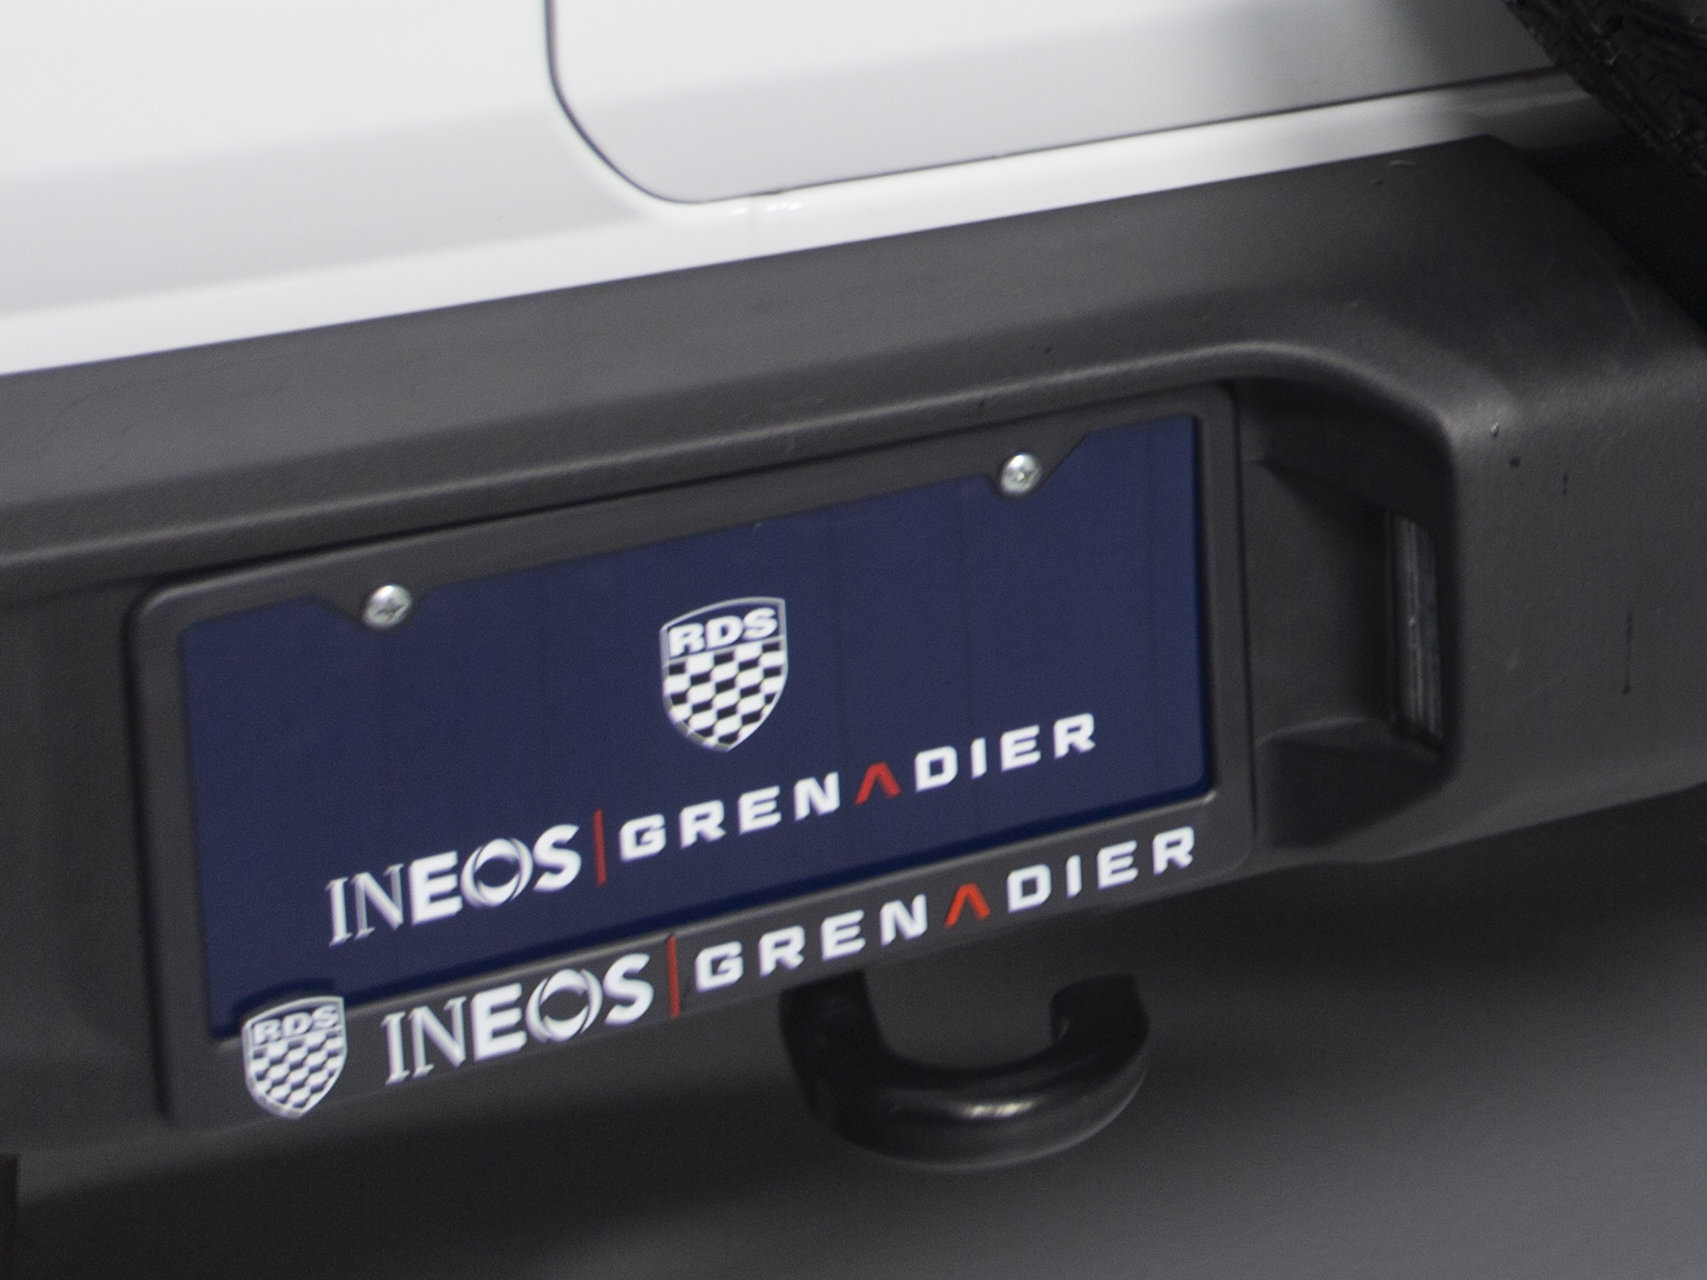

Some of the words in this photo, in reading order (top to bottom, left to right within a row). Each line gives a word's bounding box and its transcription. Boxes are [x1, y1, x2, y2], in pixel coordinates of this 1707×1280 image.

[668, 604, 778, 659] RDS
[324, 823, 582, 947] INEOS
[617, 712, 1096, 865] GRENADIER
[249, 1002, 337, 1049] RDS
[380, 951, 655, 1088] INEOS
[692, 825, 1196, 995] GRENADIER
